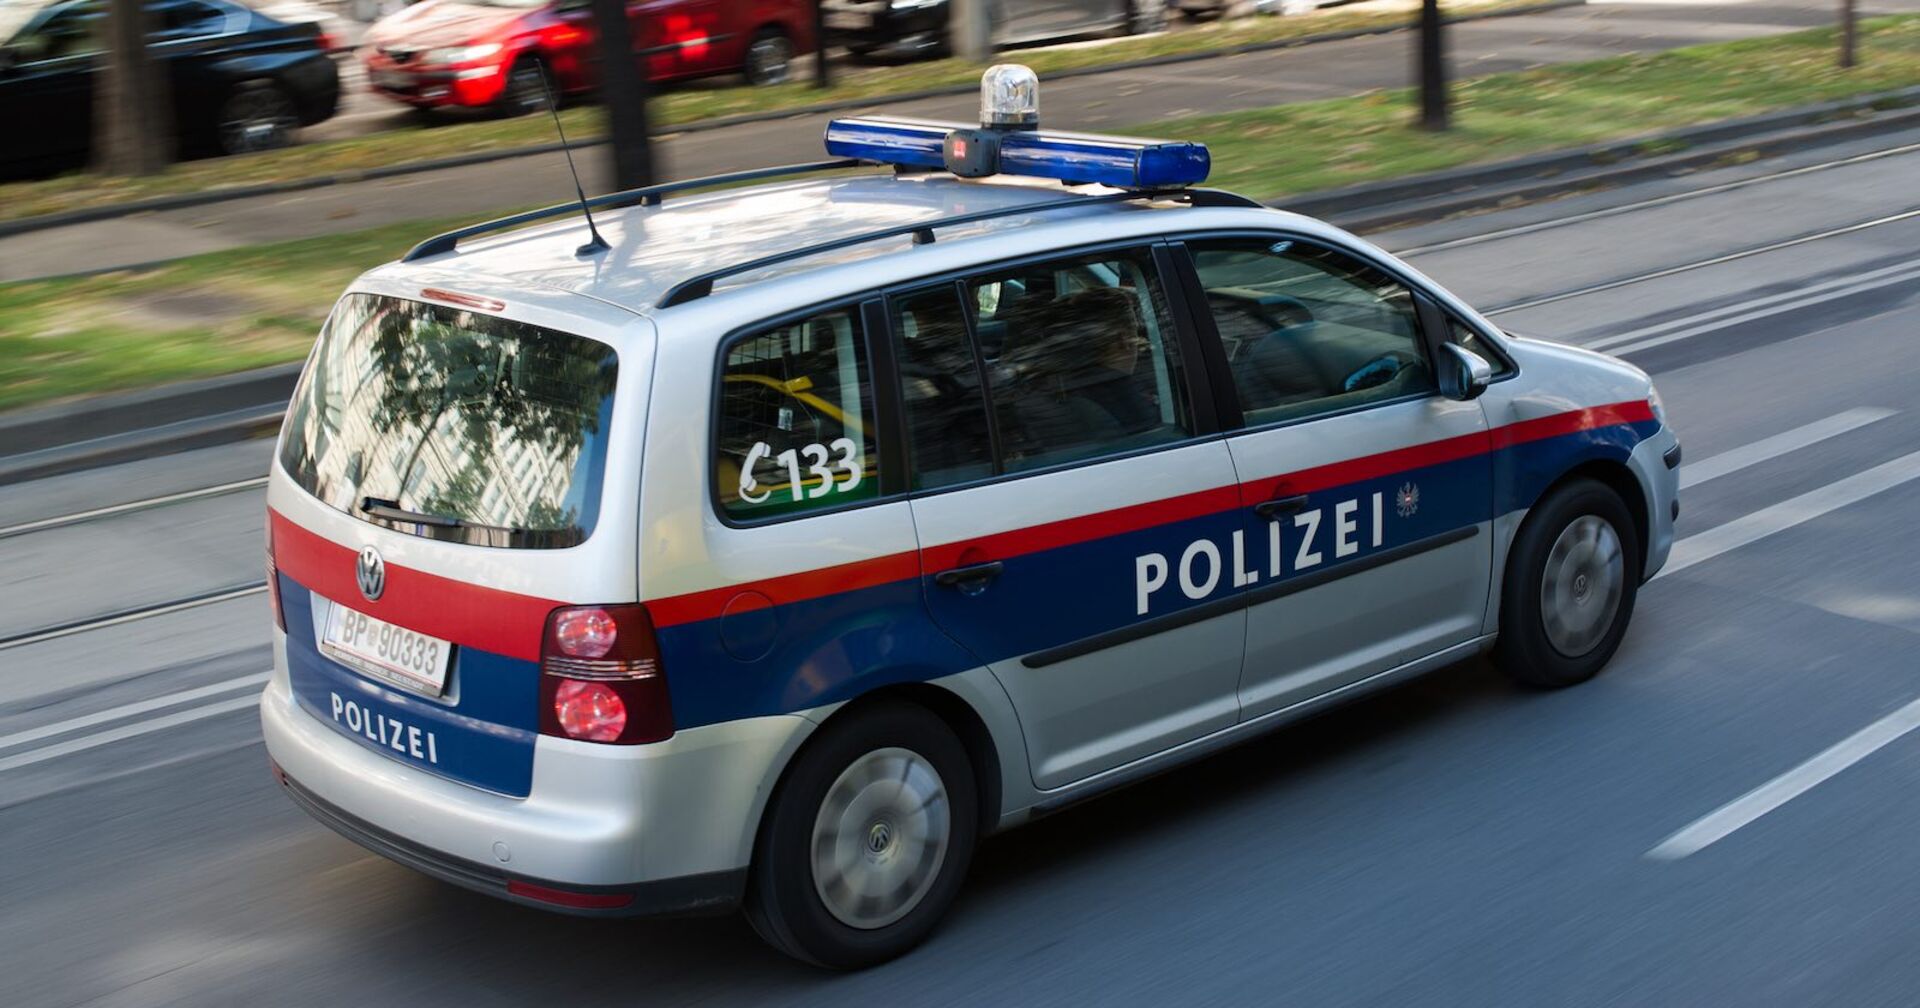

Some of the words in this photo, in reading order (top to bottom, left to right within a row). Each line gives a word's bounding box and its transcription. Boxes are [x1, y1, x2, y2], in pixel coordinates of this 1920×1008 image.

[777, 438, 862, 501] 133
[1136, 491, 1383, 615] POLIZEI
[342, 609, 368, 646] BP
[378, 623, 439, 675] 90333
[331, 692, 437, 763] POLIZEI
